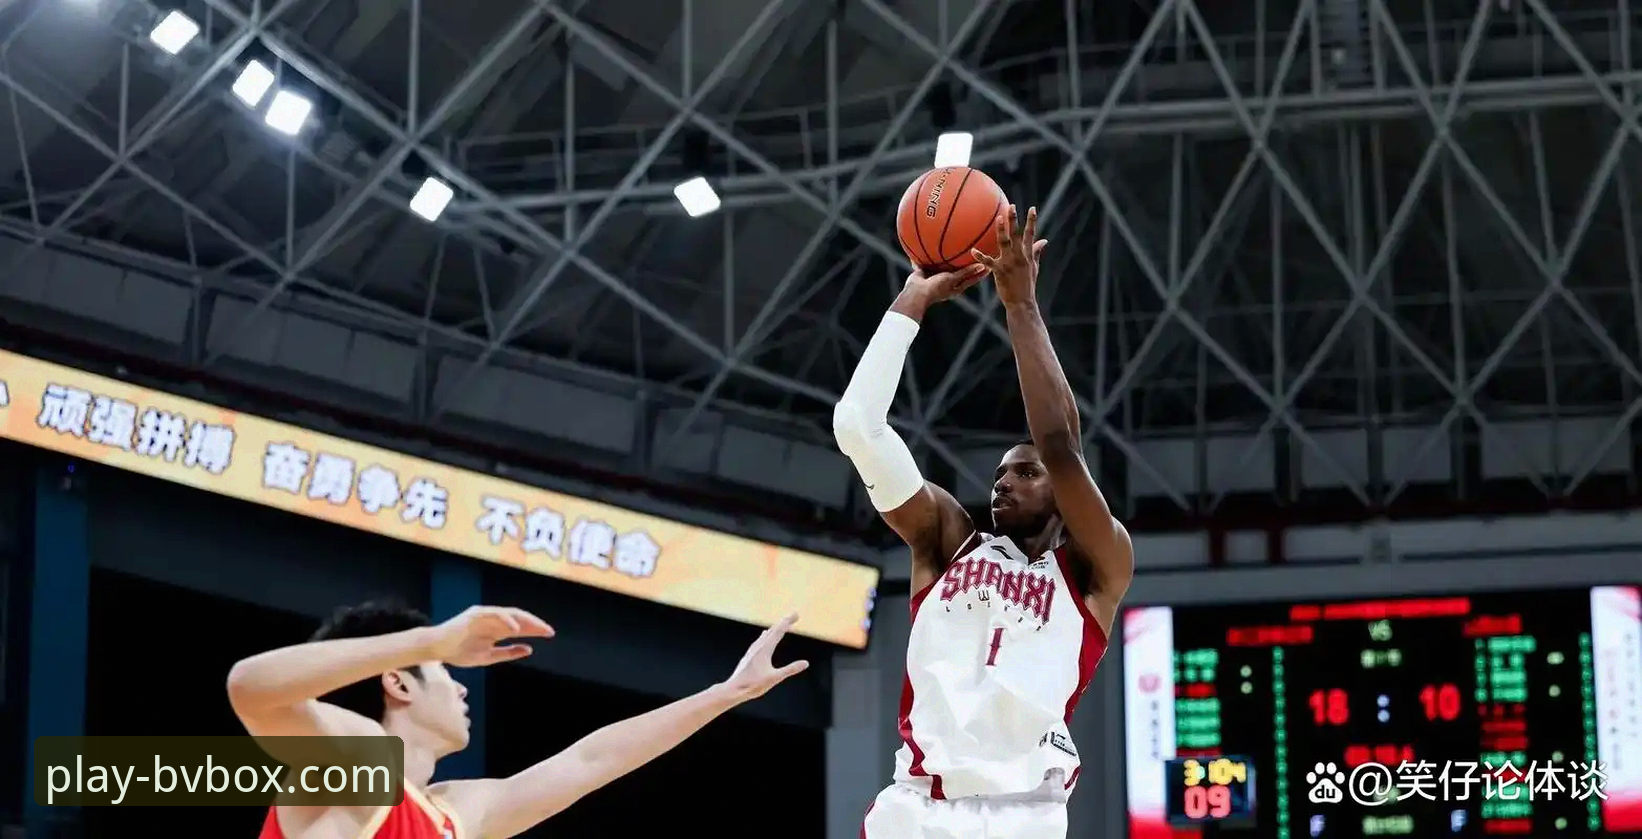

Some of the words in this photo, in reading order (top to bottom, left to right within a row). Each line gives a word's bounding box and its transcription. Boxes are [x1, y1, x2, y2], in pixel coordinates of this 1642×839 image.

[35, 381, 237, 474] 顽强拼搏
[261, 438, 450, 530] 奋勇争先
[475, 494, 663, 579] 不负使命
[940, 556, 1056, 625] SHANXI
[1309, 688, 1350, 726] 18
[1419, 682, 1461, 721] 10
[1184, 785, 1231, 819] 09
